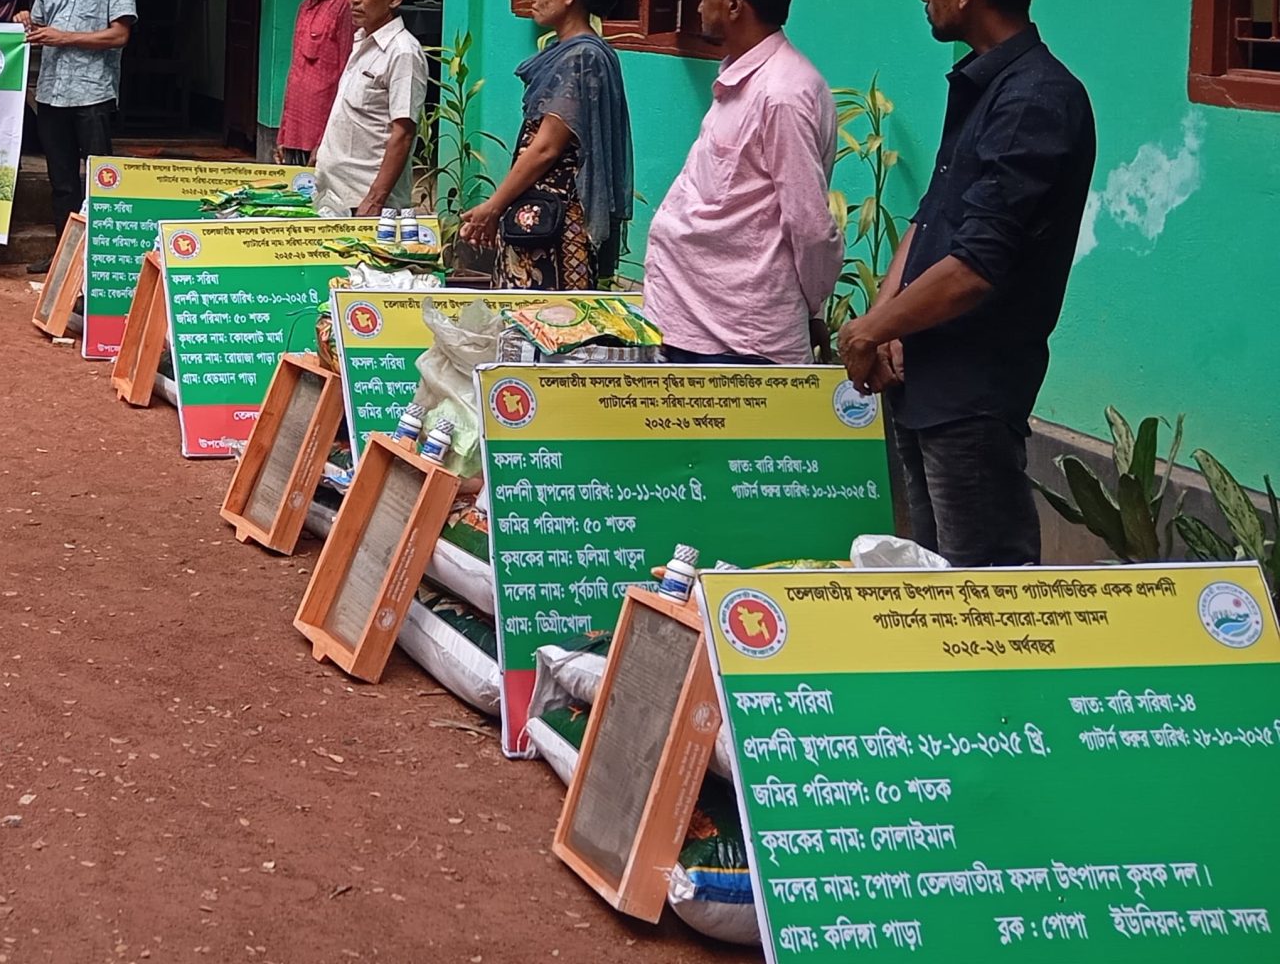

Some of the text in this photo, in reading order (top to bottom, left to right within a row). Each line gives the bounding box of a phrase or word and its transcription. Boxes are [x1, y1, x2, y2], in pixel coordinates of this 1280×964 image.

[196, 271, 219, 285] সরিষা
[378, 353, 406, 371] সরিষা
[529, 447, 562, 470] সরিষা
[754, 456, 774, 474] বারি
[777, 456, 818, 474] সরিষা-১৪
[496, 478, 532, 503] প্রদর্শনী
[536, 483, 576, 506] স্থাপনের
[617, 484, 686, 503] ১০-১১-২০২৫
[498, 512, 529, 535] জমির
[583, 518, 601, 534] ৫০
[604, 515, 636, 533] শতক
[500, 550, 544, 576] কৃষকের
[613, 548, 645, 571] খাতুন
[504, 583, 536, 602] দলের
[784, 683, 834, 715] সরিষা
[1105, 689, 1134, 714] বারি
[1135, 688, 1196, 713] সরিষা-১৪
[743, 727, 797, 763] প্রদর্শনী
[801, 734, 859, 766] স্থাপনের
[918, 732, 1022, 759] ২৮-১০-২০২৫
[750, 775, 798, 808] জমির
[875, 781, 901, 804] ৫০
[904, 777, 951, 802] শতক
[758, 829, 824, 866] কৃষকের
[870, 820, 956, 852] সোলাইমান
[768, 877, 818, 904] দলের
[861, 871, 912, 899] পোপা
[917, 860, 1004, 897] তেলজাতীয়
[1007, 868, 1051, 892] ফসল
[1052, 859, 1121, 890] উৎপাদন
[1123, 863, 1168, 899] কৃষক
[882, 919, 923, 951] পাড়া
[1042, 912, 1088, 939] পোপা
[1188, 908, 1228, 936] লামা
[1229, 909, 1270, 933] সদর
